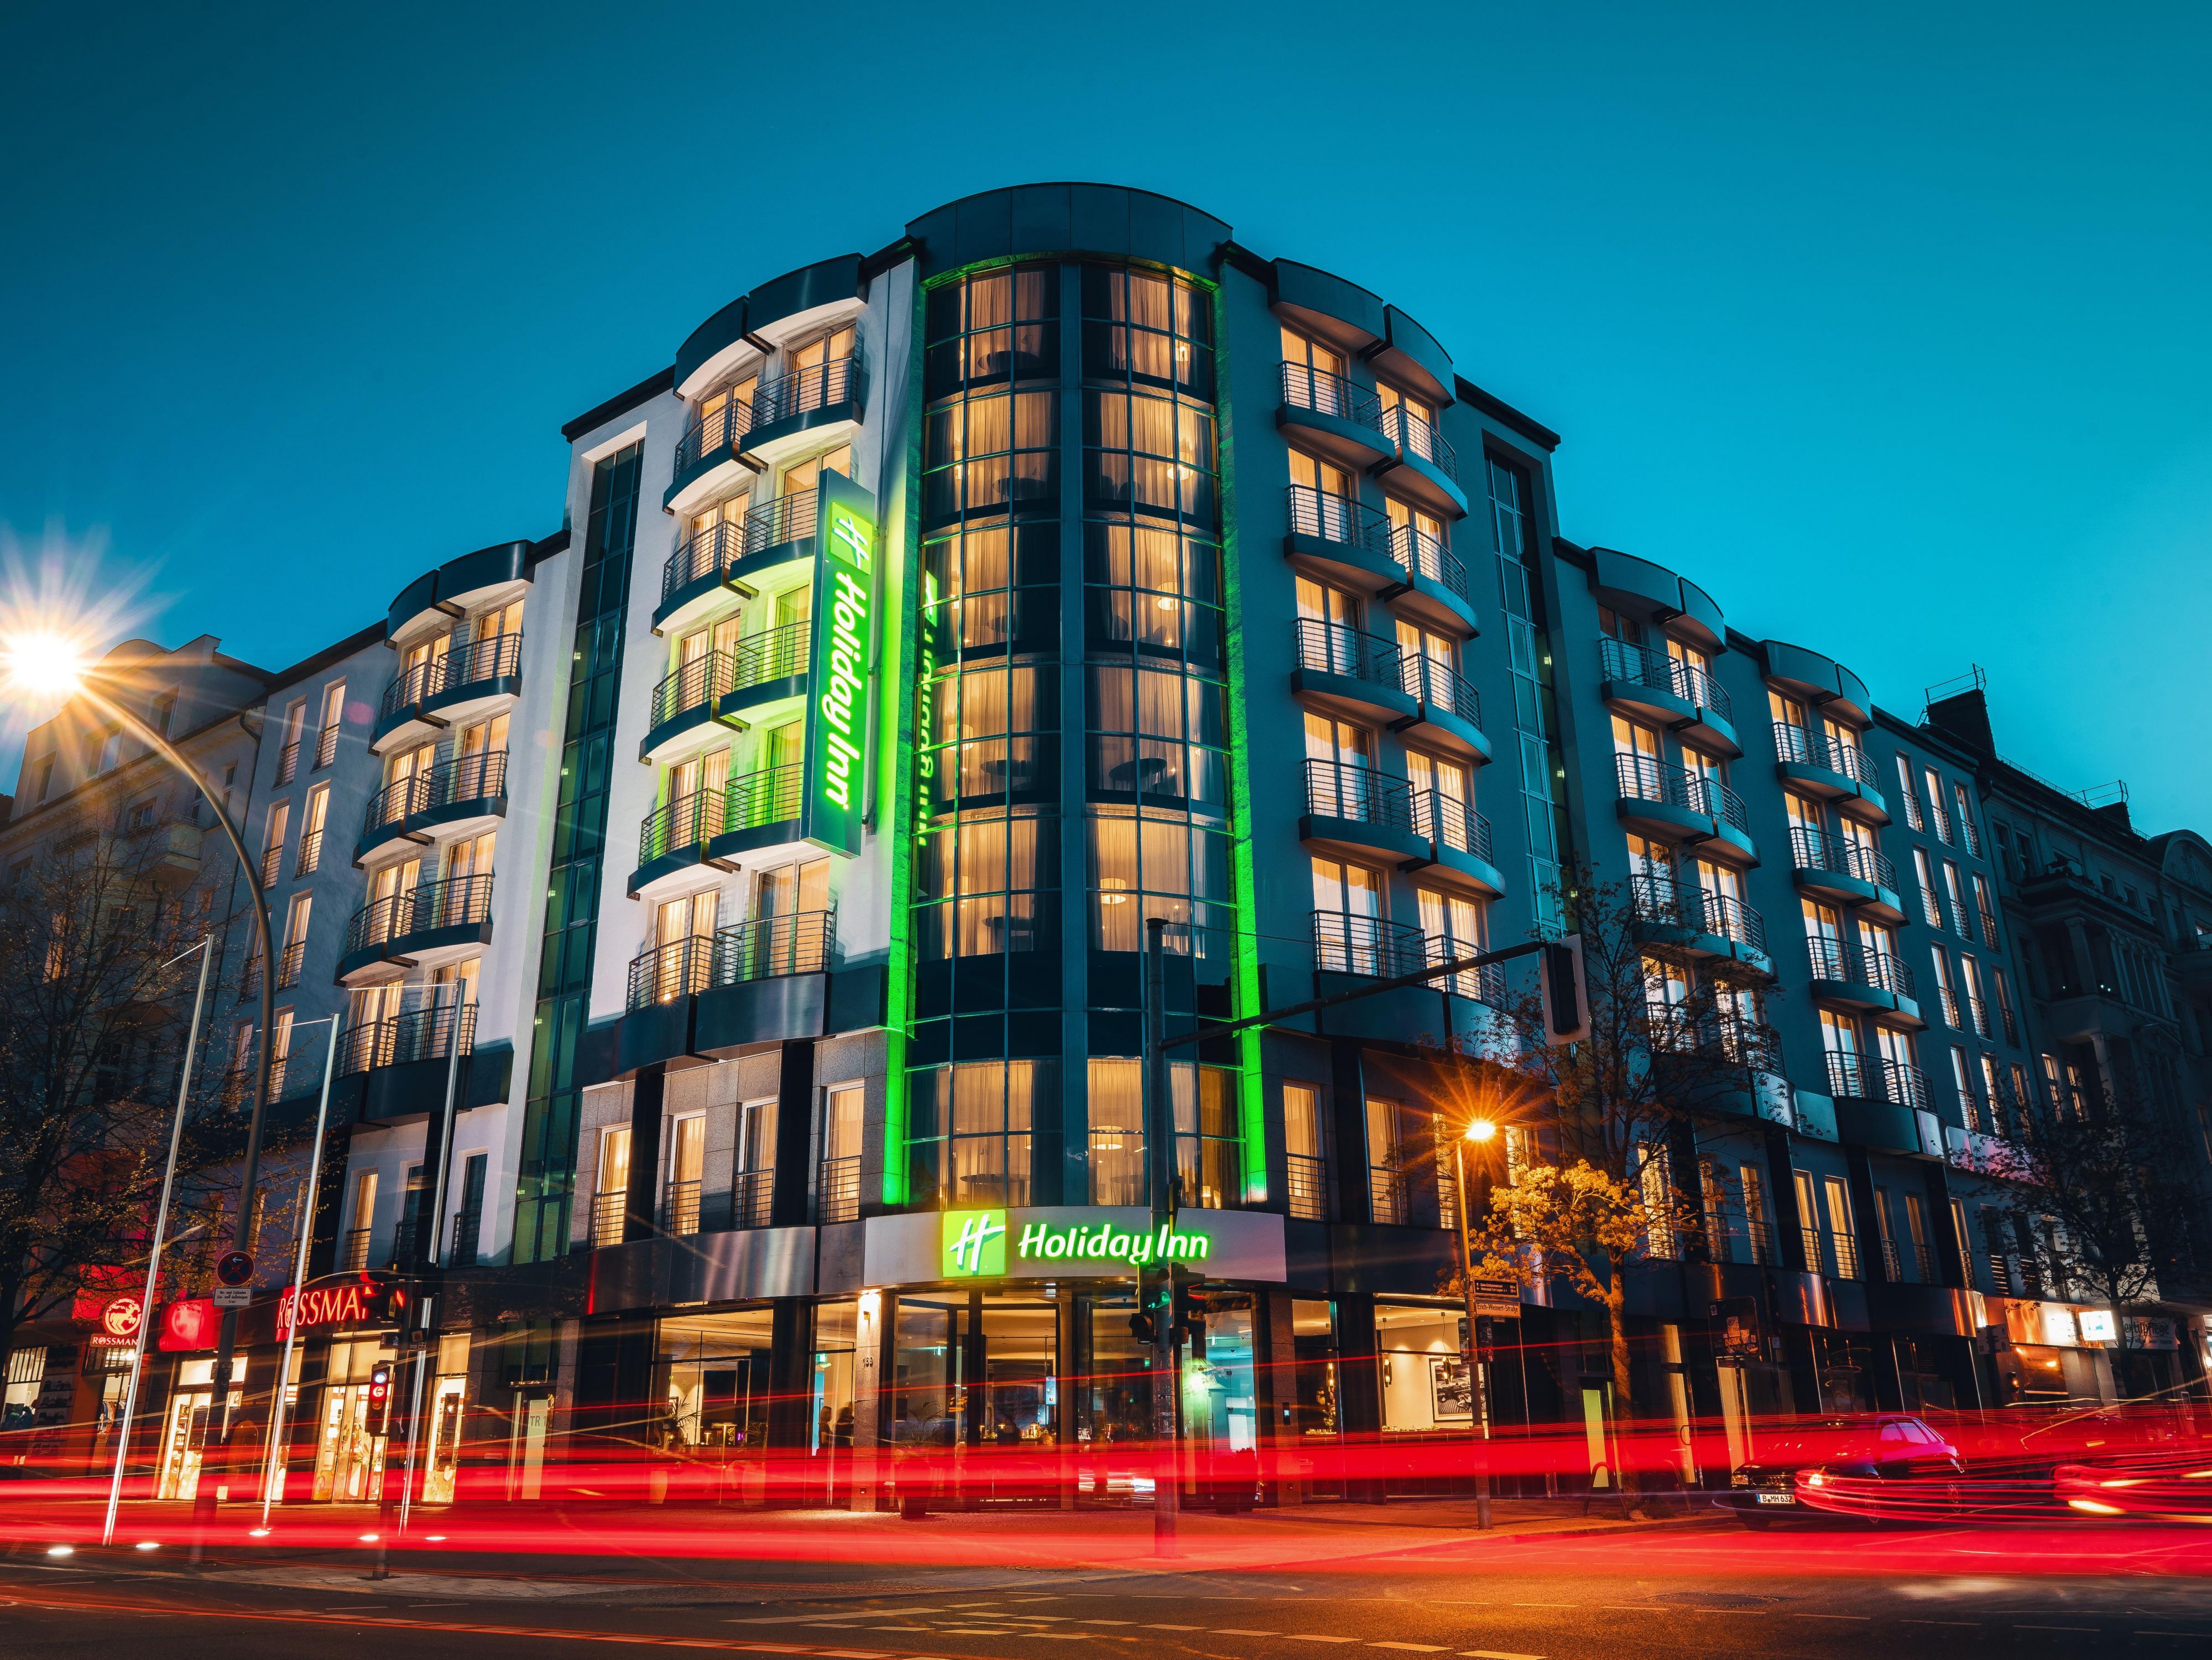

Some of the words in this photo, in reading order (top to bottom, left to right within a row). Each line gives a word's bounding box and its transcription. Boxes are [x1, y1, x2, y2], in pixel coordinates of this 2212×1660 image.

[822, 571, 867, 735] Holiday
[826, 733, 860, 805] Inn
[1018, 1223, 1152, 1265] Holiday
[1156, 1224, 1208, 1258] Inn
[1477, 1303, 1519, 1314] Erich-Weinert-Straße
[92, 1337, 138, 1346] ROSSMAN
[530, 1415, 540, 1427] TR
